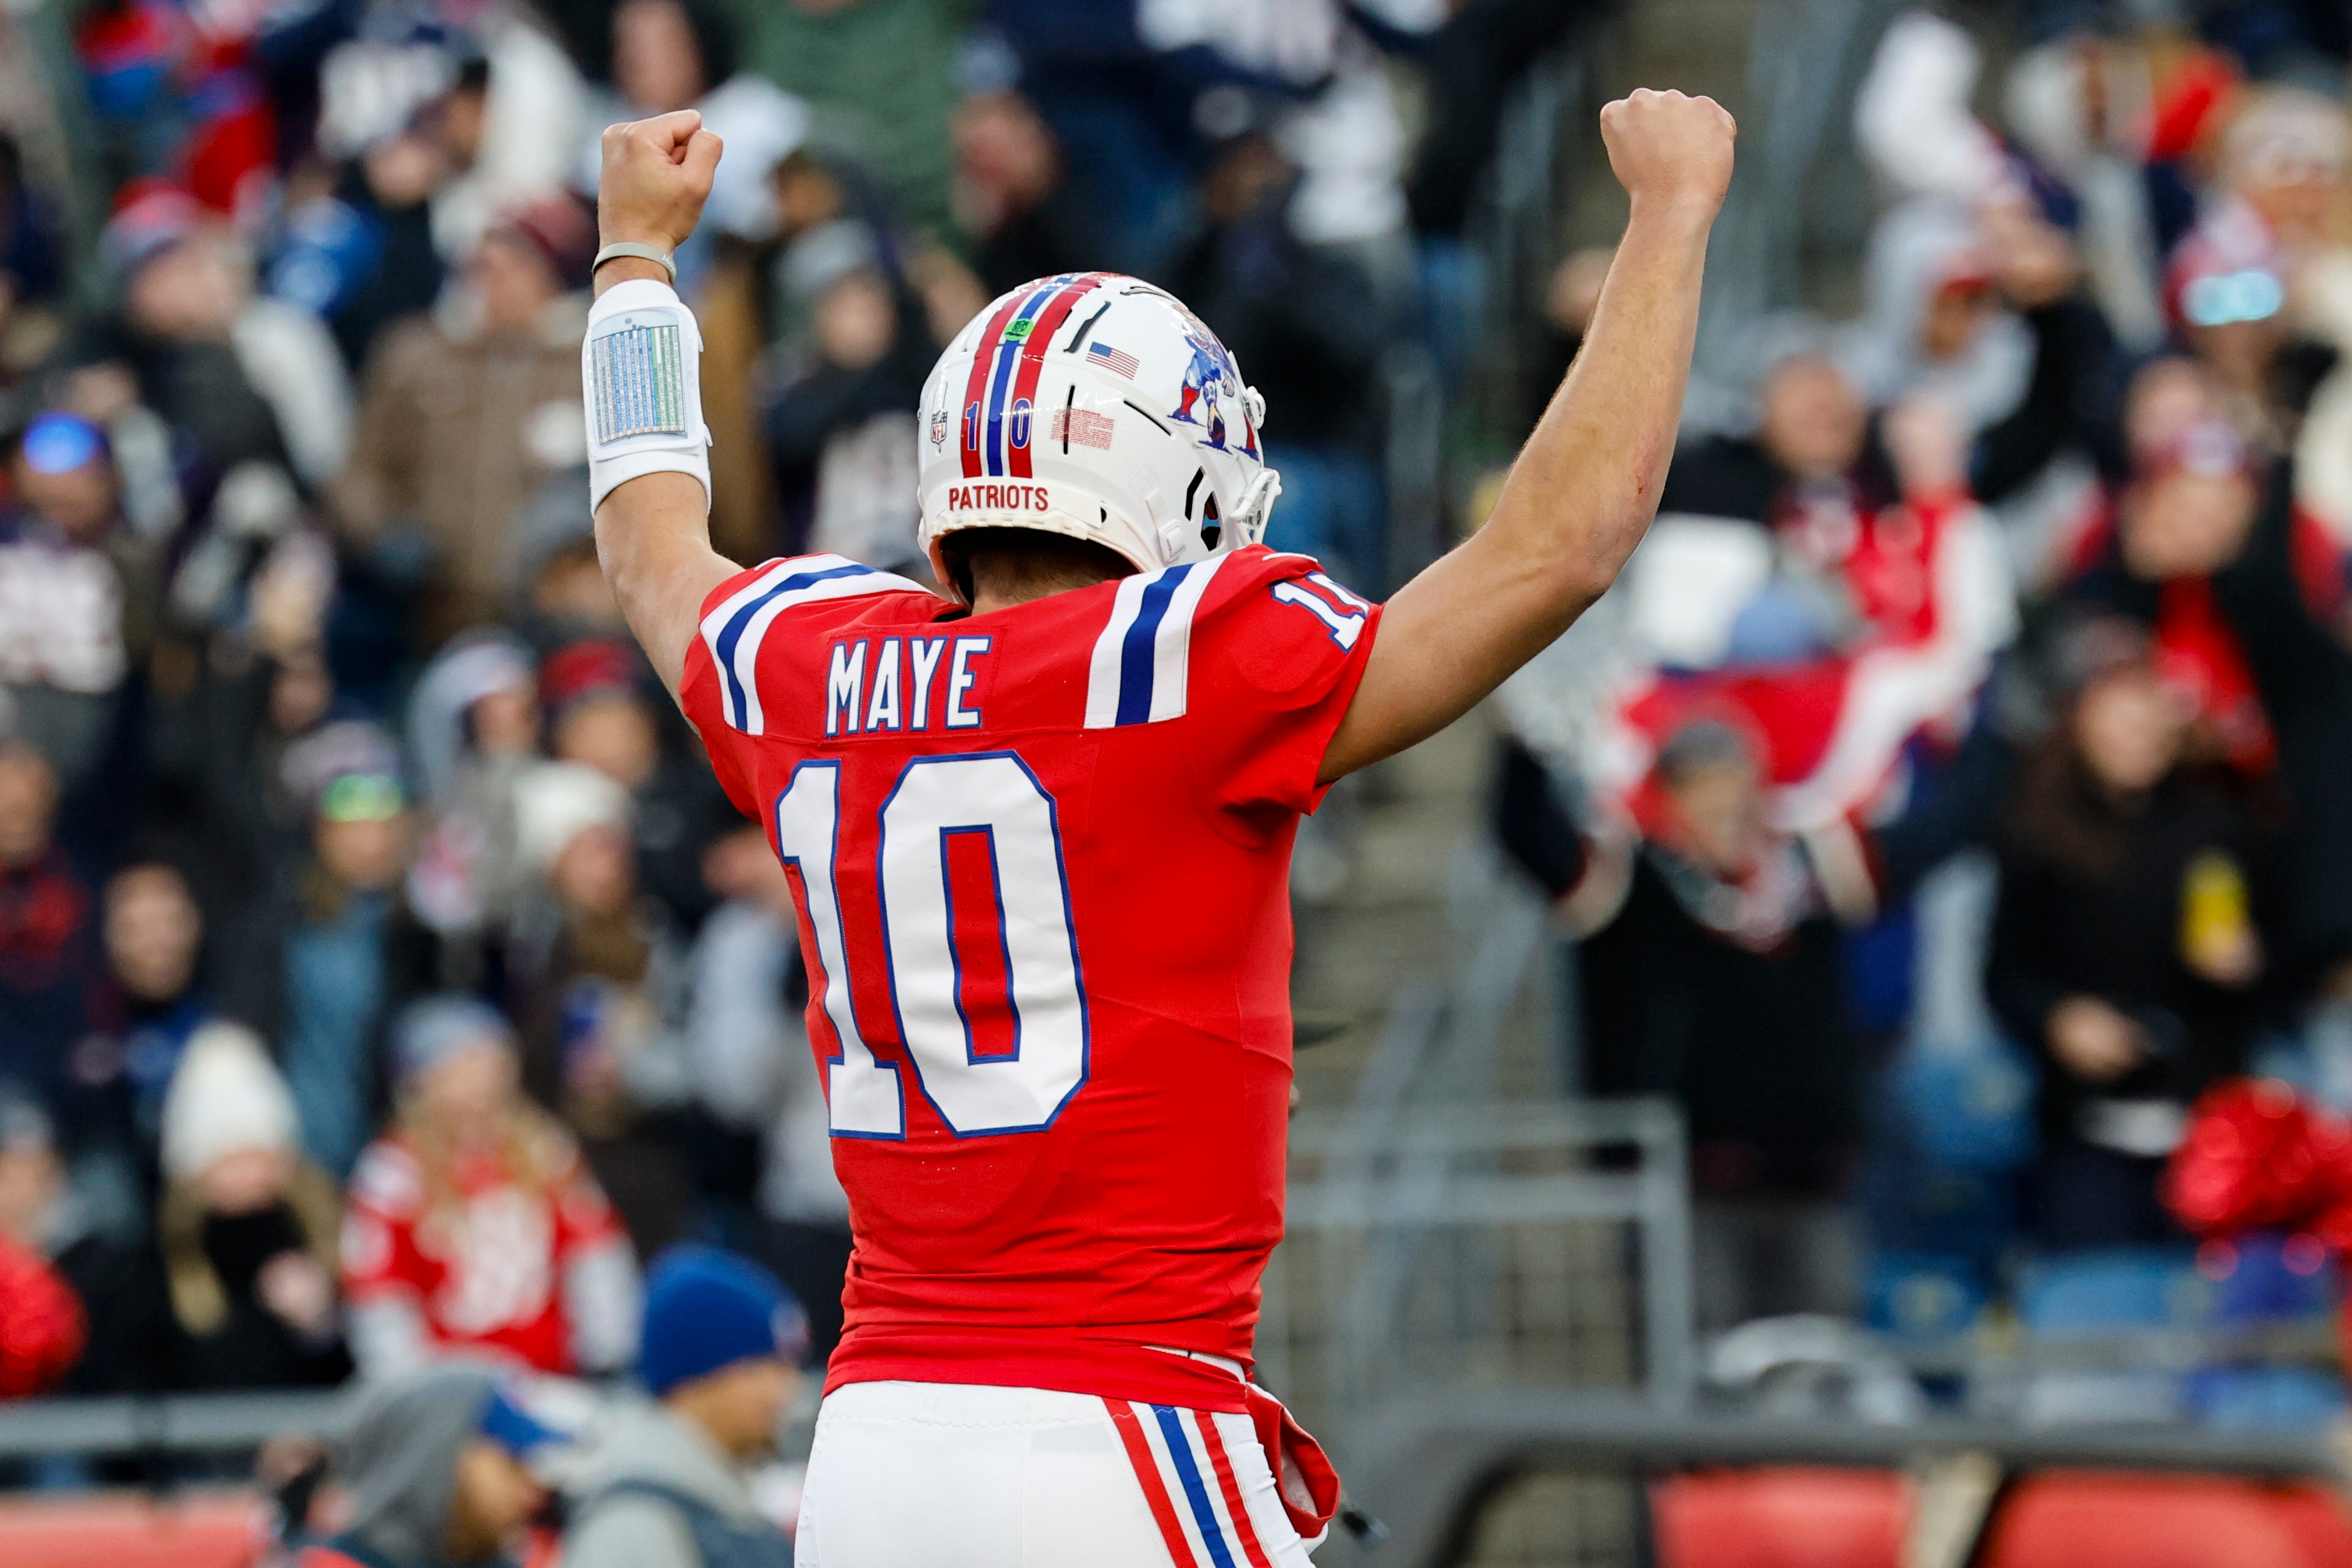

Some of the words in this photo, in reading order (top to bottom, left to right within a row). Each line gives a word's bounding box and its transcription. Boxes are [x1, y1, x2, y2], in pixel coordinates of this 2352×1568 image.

[931, 424, 945, 441] NFL
[949, 484, 1049, 511] PATRIOTS
[824, 635, 992, 737] MAYE
[775, 749, 1090, 1140] 10
